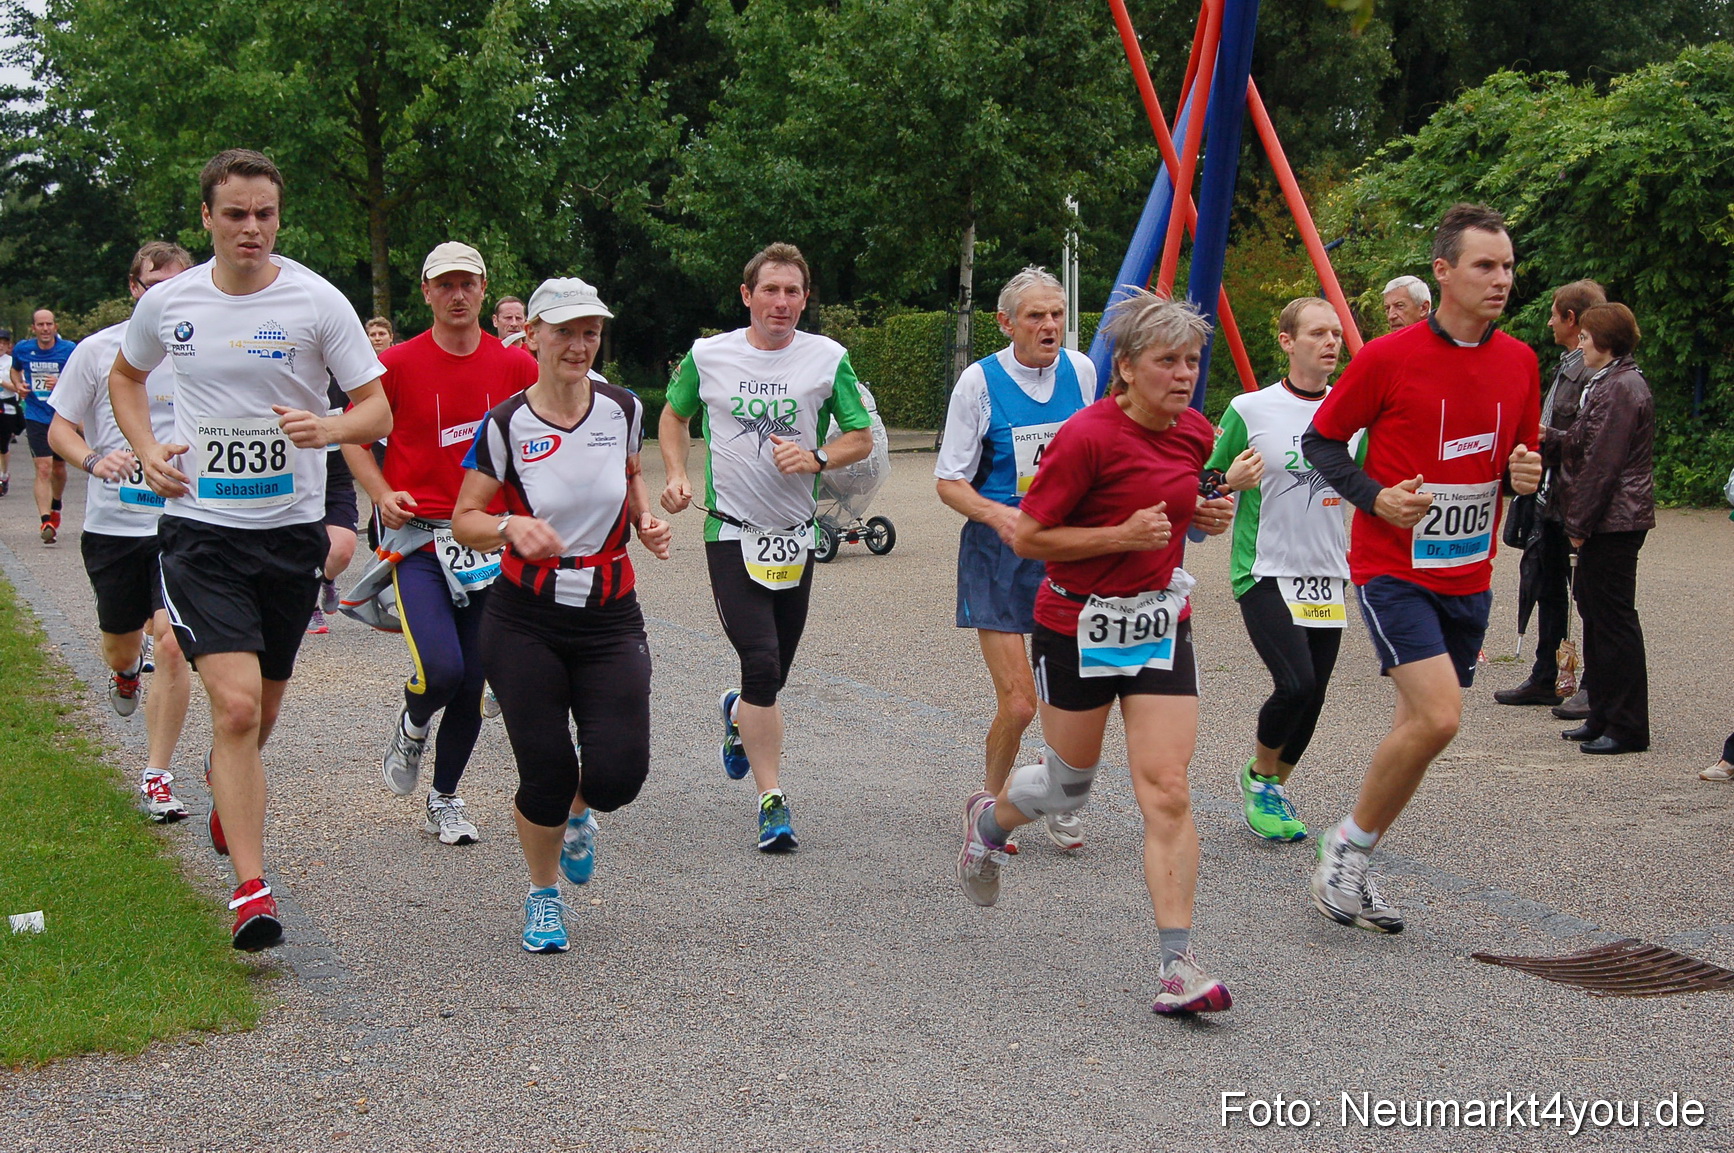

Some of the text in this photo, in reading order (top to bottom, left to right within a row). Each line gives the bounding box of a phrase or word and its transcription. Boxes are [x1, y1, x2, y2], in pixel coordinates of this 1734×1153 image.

[229, 340, 245, 348] 14.
[739, 380, 787, 395] FÜRTH
[730, 396, 798, 426] 2013
[198, 426, 279, 437] PARTL Neumarkt
[453, 427, 474, 439] DEHN
[1015, 433, 1043, 441] PARTL
[522, 440, 550, 455] tkn
[1457, 440, 1480, 452] DEHN
[206, 439, 287, 474] 2638
[215, 482, 279, 496] Sebastian
[1451, 491, 1490, 501] Neumarkt
[137, 492, 167, 506] Micha
[1424, 502, 1491, 536] 2005
[757, 537, 800, 562] 239
[1426, 541, 1481, 556] Dr. Philipp
[766, 570, 788, 580] Franz
[1293, 576, 1332, 601] 238
[1303, 607, 1331, 618] Norbert
[1089, 607, 1170, 644] 3190
